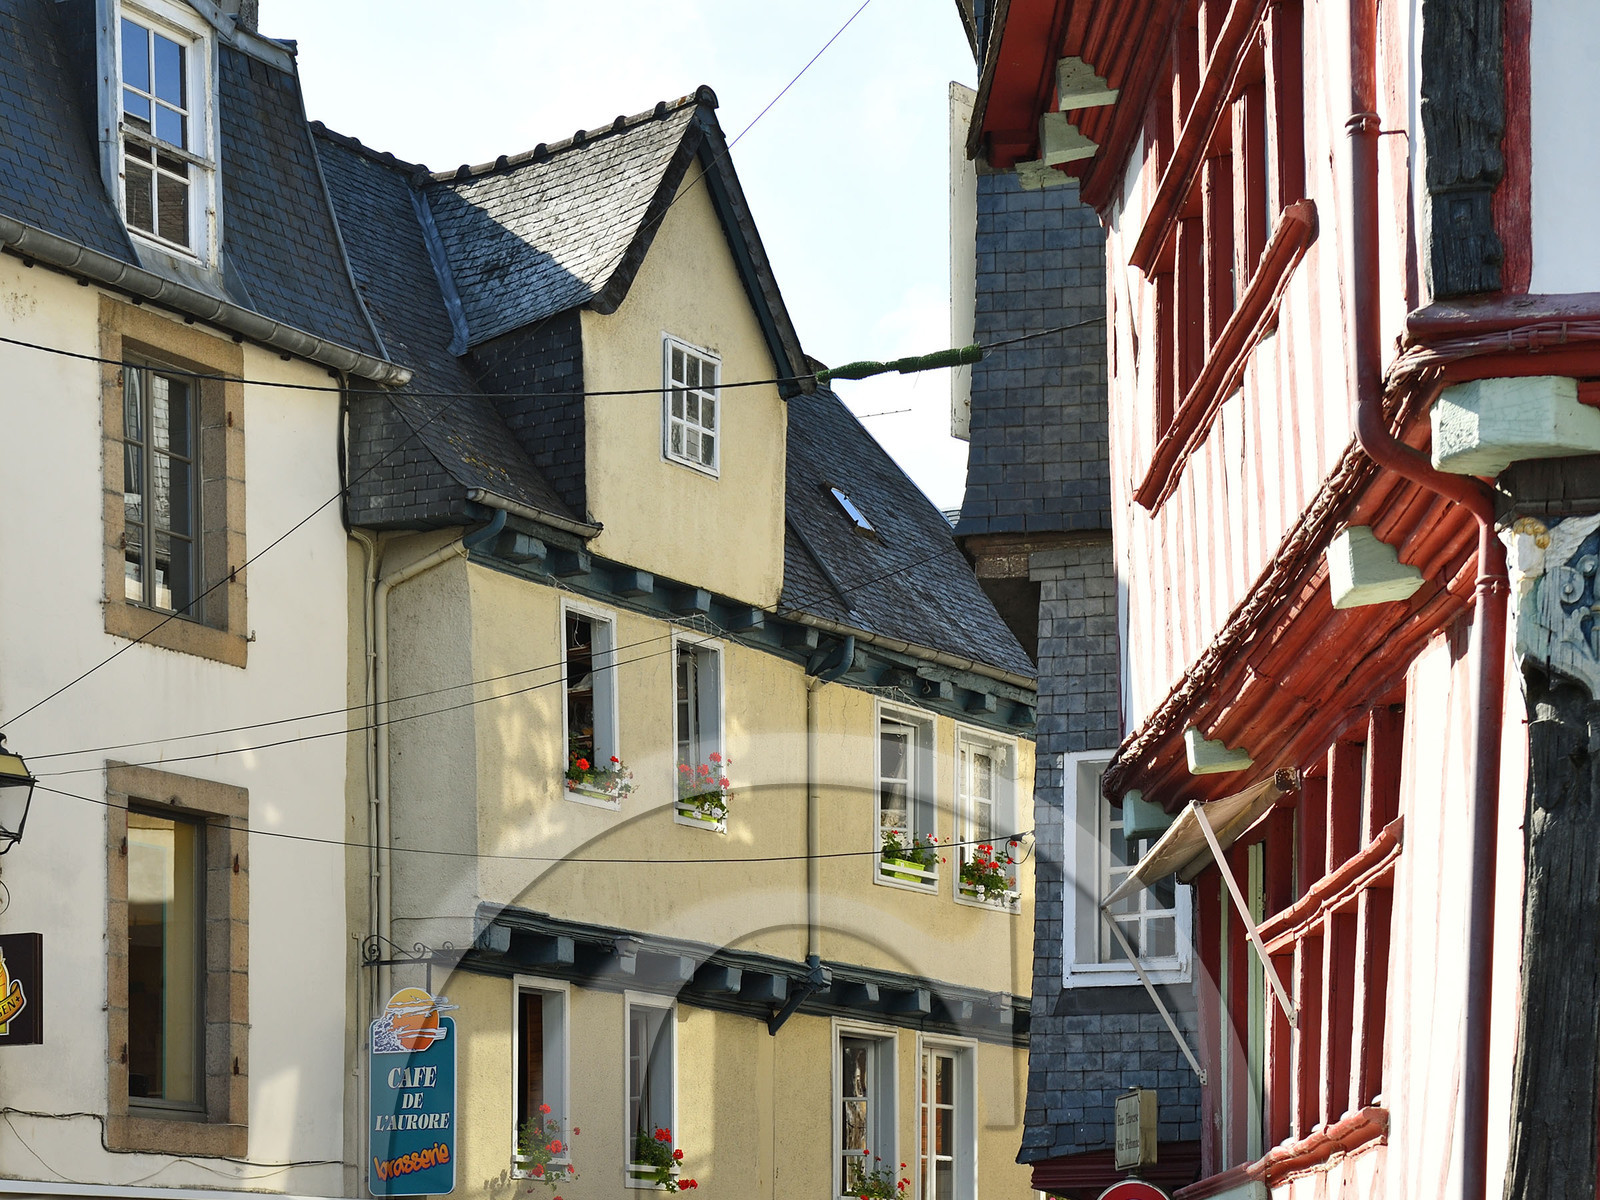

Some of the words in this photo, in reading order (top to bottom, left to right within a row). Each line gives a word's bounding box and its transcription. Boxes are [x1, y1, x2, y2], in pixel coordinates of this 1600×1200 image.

[387, 1065, 438, 1089] CAFE
[401, 1092, 424, 1110] DE
[374, 1112, 450, 1132] L'AURORE
[373, 1142, 451, 1182] brasserie
